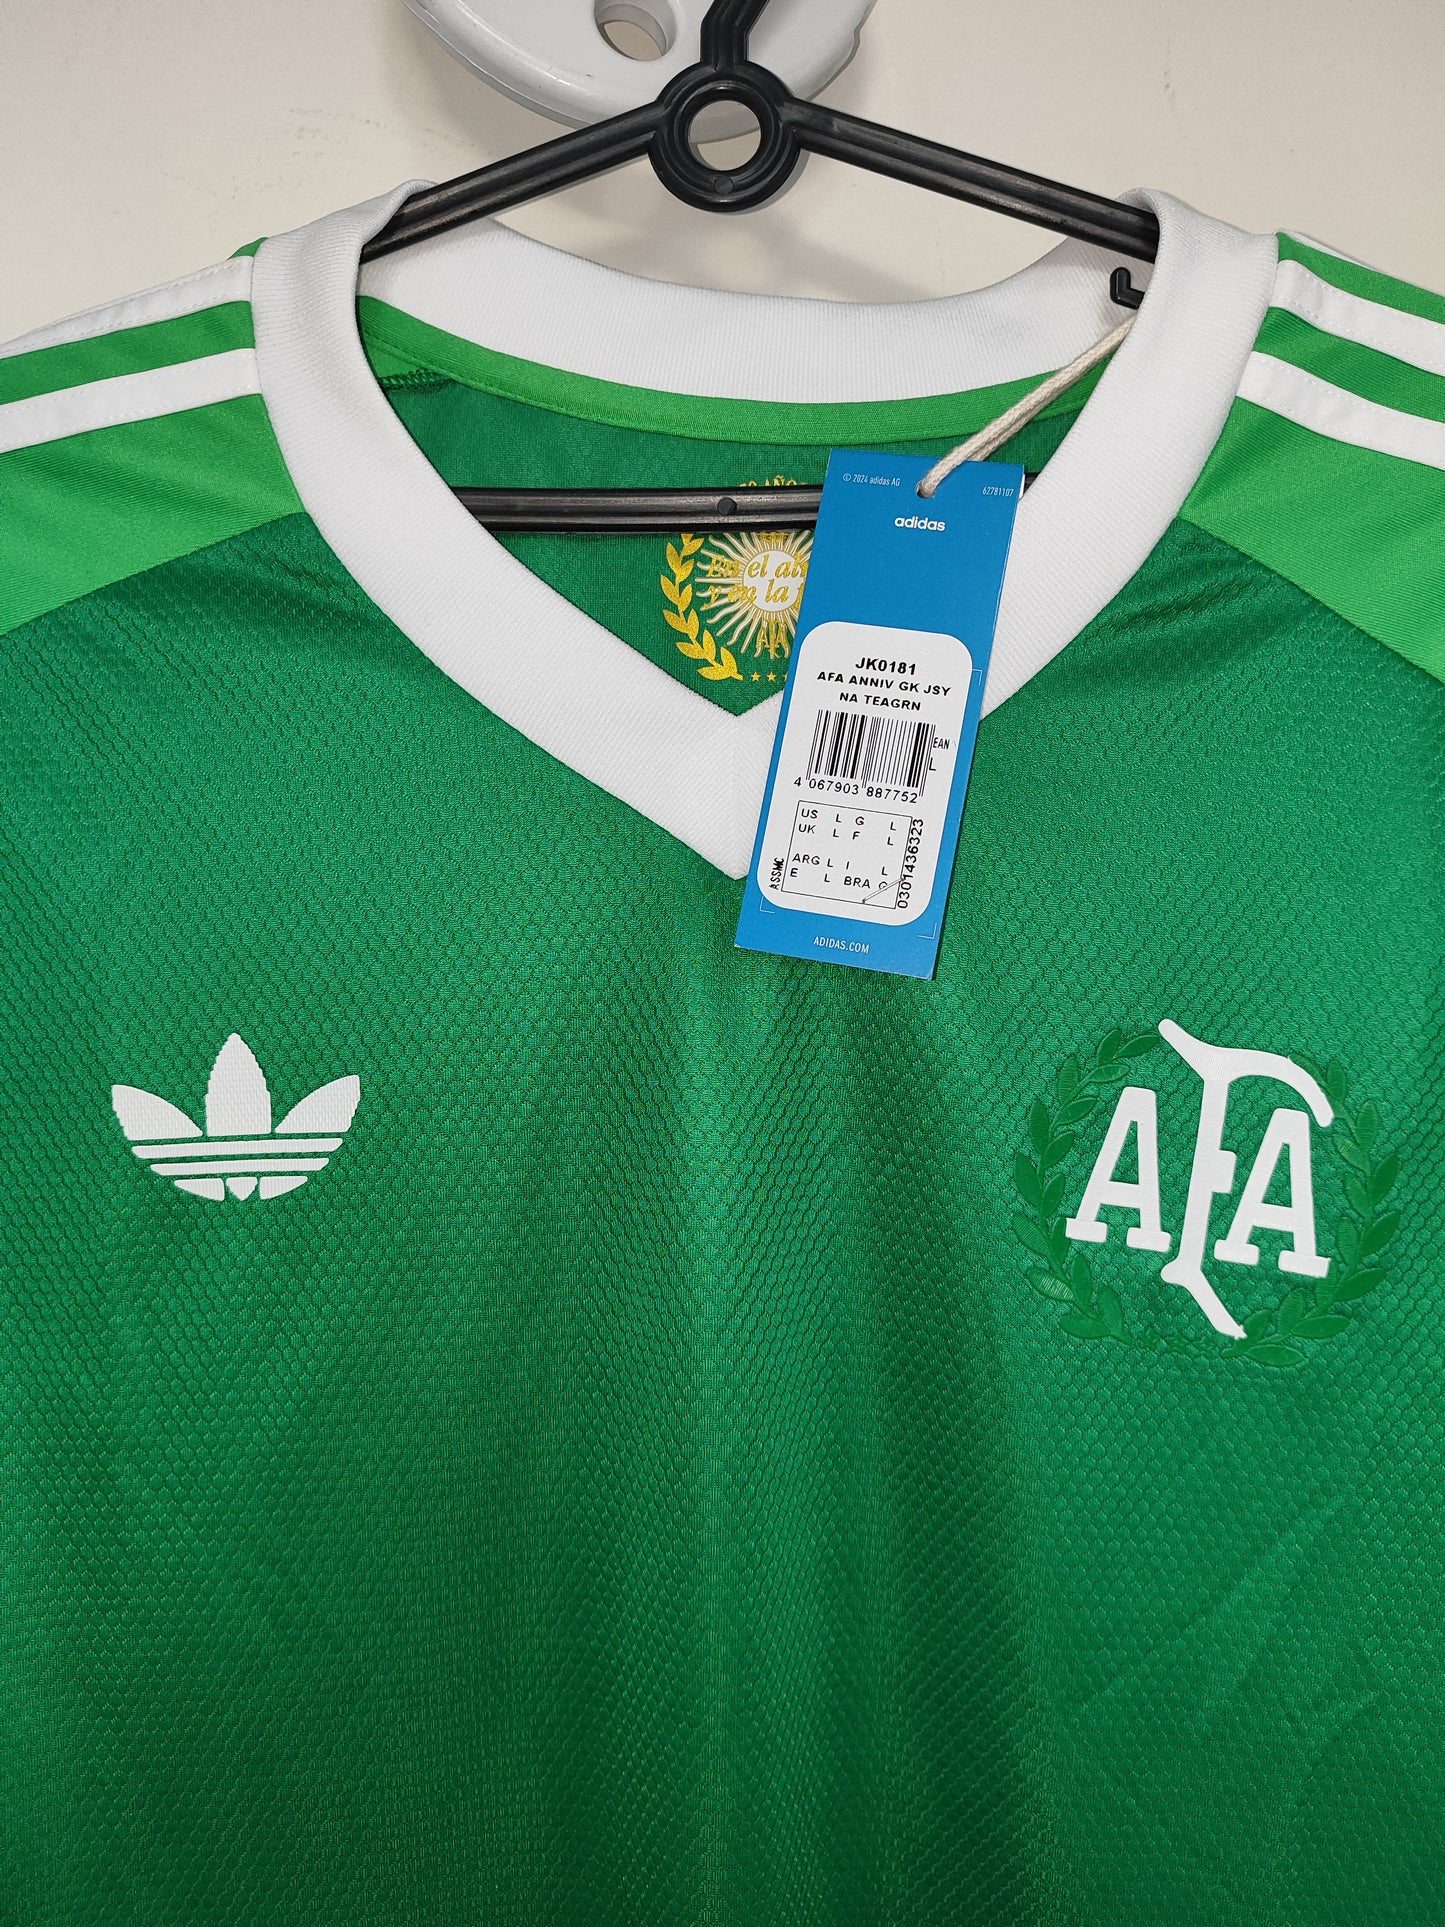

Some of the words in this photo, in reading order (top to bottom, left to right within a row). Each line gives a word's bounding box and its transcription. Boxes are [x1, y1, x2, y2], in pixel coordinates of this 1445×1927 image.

[853, 473, 868, 483] 2024
[870, 476, 890, 486] adidas
[891, 478, 901, 487] AG
[982, 486, 1014, 497] 62781107
[894, 515, 946, 532] adidas
[747, 553, 770, 578] el
[765, 578, 790, 603] la
[855, 657, 916, 676] JK0181
[817, 671, 844, 683] AFA
[848, 675, 895, 689] ANNIV
[898, 681, 920, 693] GK
[923, 684, 952, 697] JSY
[839, 692, 858, 703] NA
[863, 694, 922, 711] TEAGRN
[932, 736, 950, 750] EAN
[928, 756, 937, 771] L
[793, 776, 802, 787] 4
[808, 778, 859, 795] 067903
[865, 786, 918, 804] 887752
[801, 808, 819, 819] US
[835, 813, 842, 823] L
[855, 816, 865, 826] G
[889, 821, 897, 831] L
[798, 823, 817, 834] UK
[832, 828, 840, 838] L
[852, 831, 861, 840] F
[887, 836, 894, 846] L
[791, 853, 821, 866] ARG
[826, 858, 834, 868] L
[881, 866, 888, 876] L
[896, 818, 925, 909] 0301436323
[789, 867, 799, 878] E
[824, 873, 831, 883] L
[843, 875, 871, 889] BRA
[813, 935, 870, 954] ADIDAS.COM
[1065, 1018, 1335, 1340] AFA
